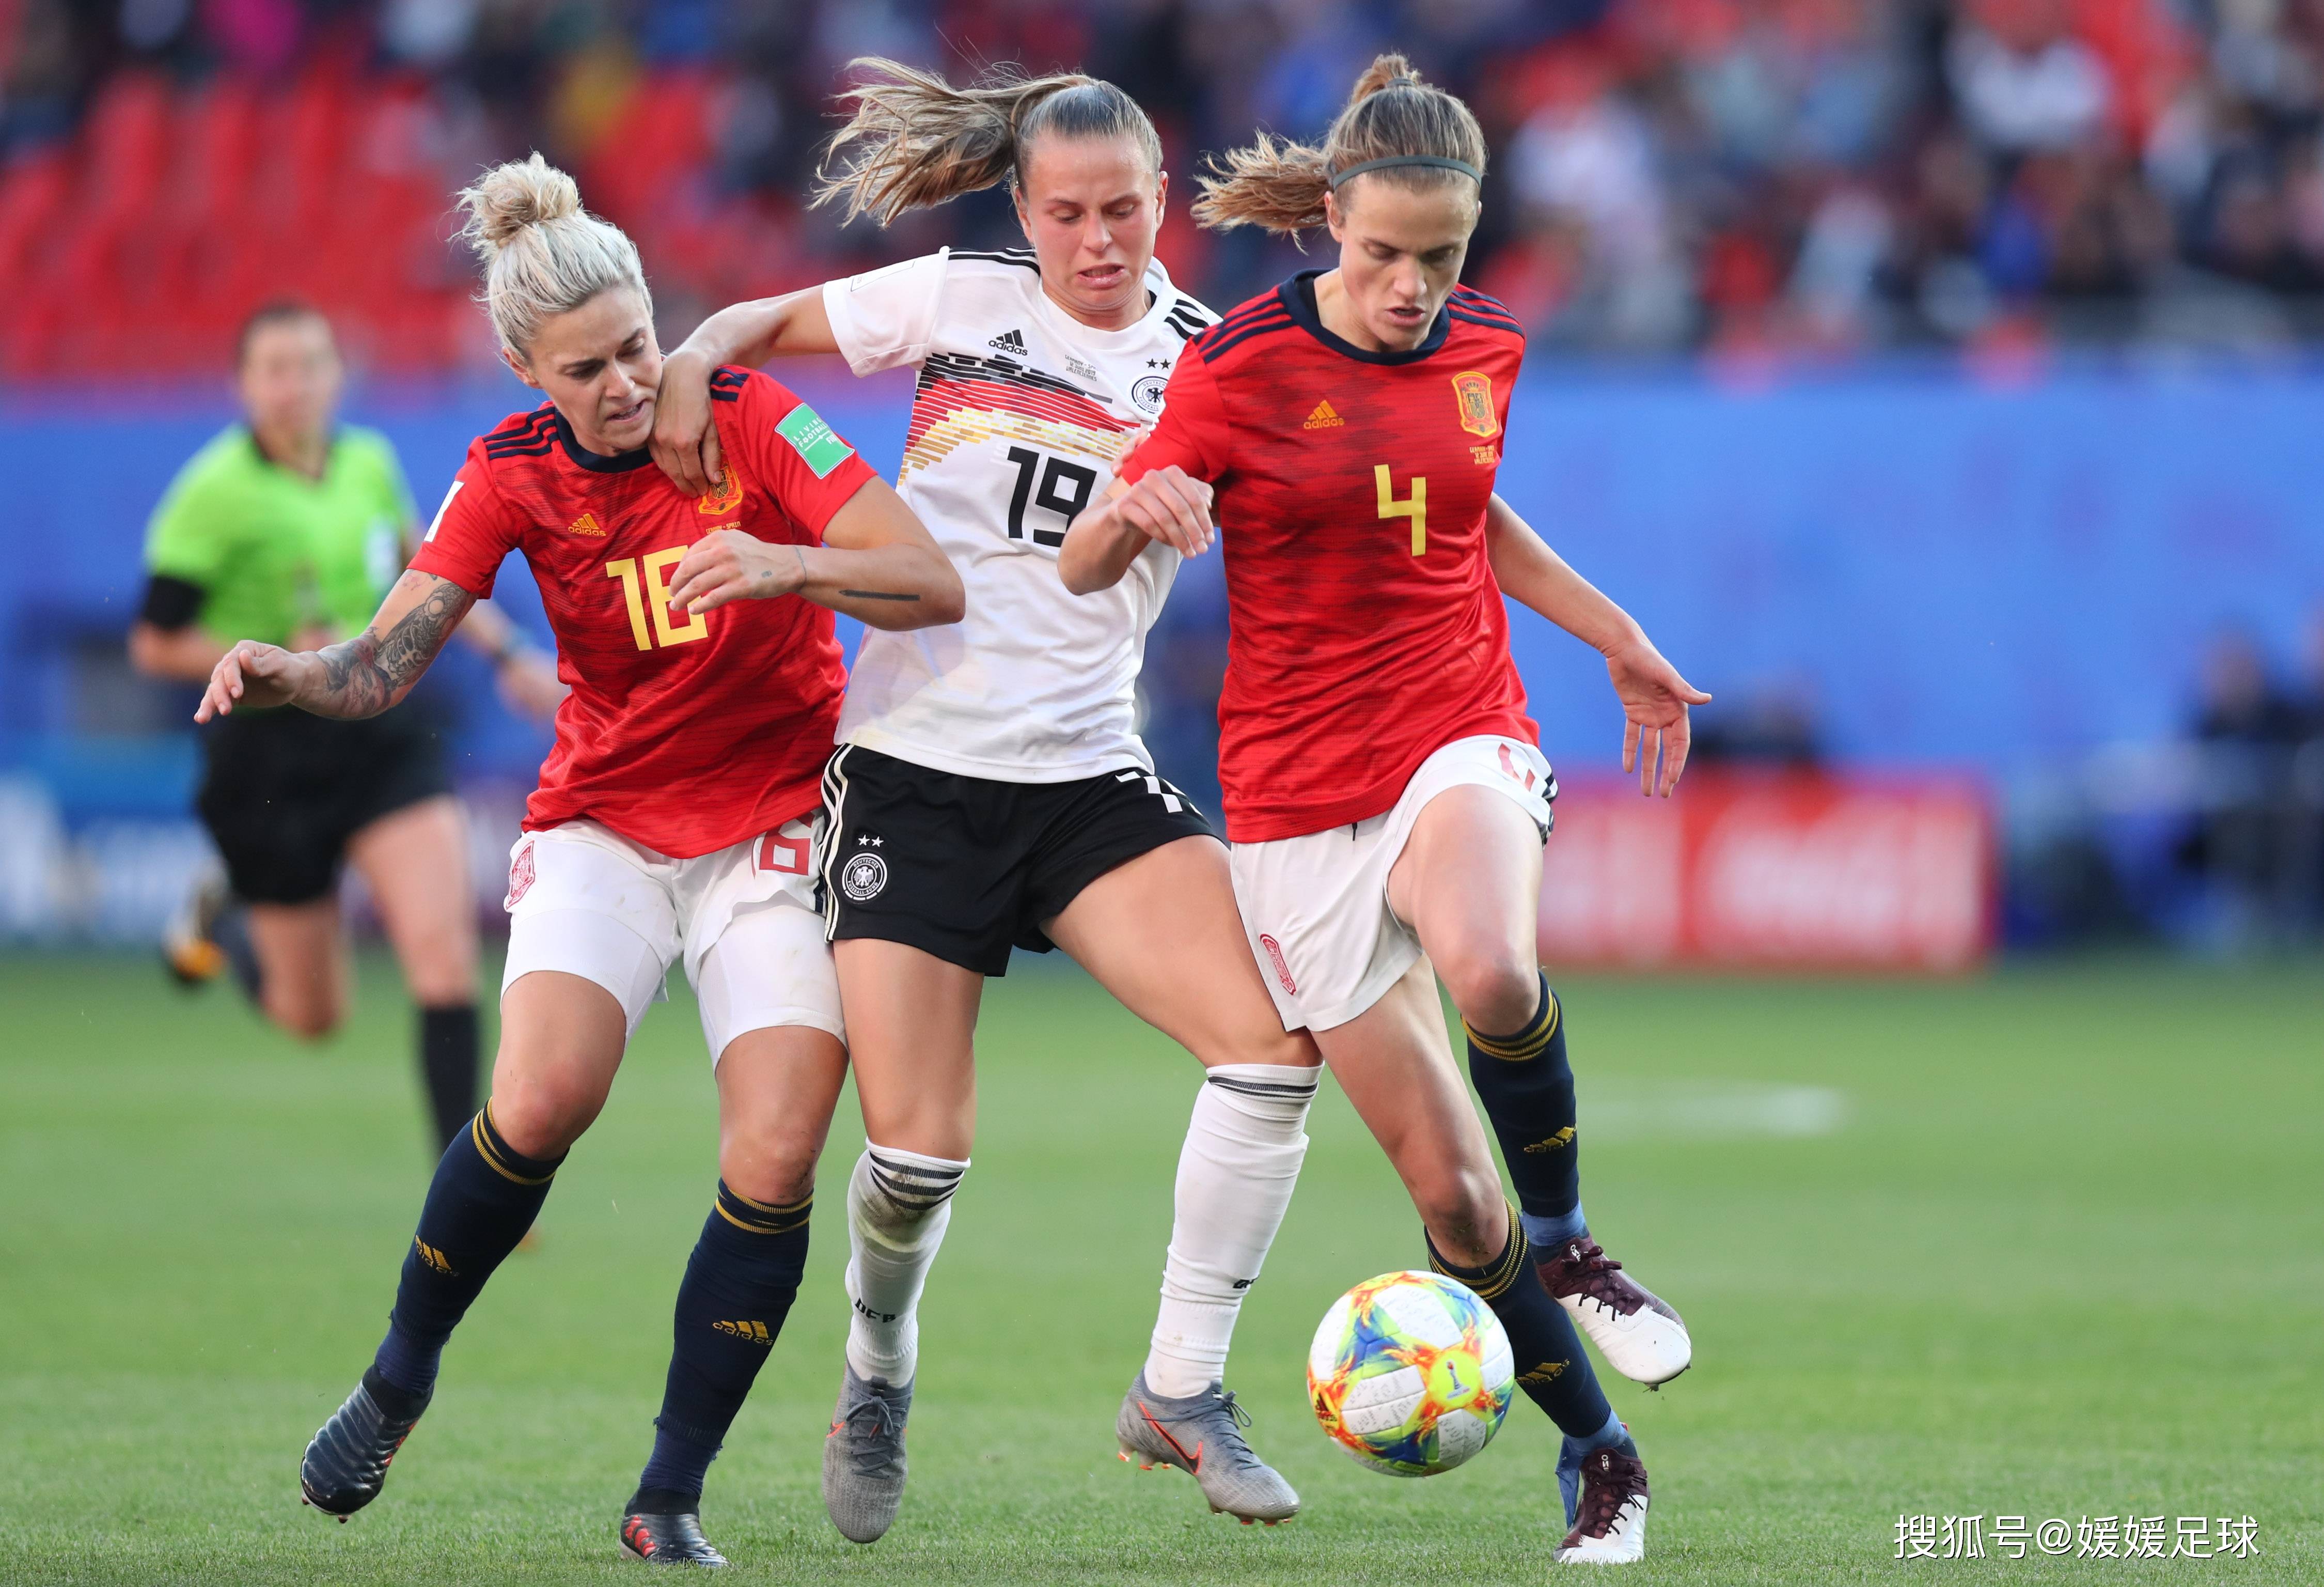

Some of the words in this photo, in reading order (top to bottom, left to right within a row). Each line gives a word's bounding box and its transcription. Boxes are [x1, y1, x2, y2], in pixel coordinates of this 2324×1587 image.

[988, 340, 1028, 356] adidas
[1303, 417, 1345, 430] adidas
[1007, 446, 1097, 548] 19
[1374, 464, 1427, 556] 4
[568, 526, 606, 536] adidas
[726, 521, 741, 529] SPAIN
[751, 810, 815, 879] 6
[853, 859, 879, 869] DEUTSCHER
[1571, 1244, 1581, 1262] ONE
[713, 1322, 774, 1345] adidas
